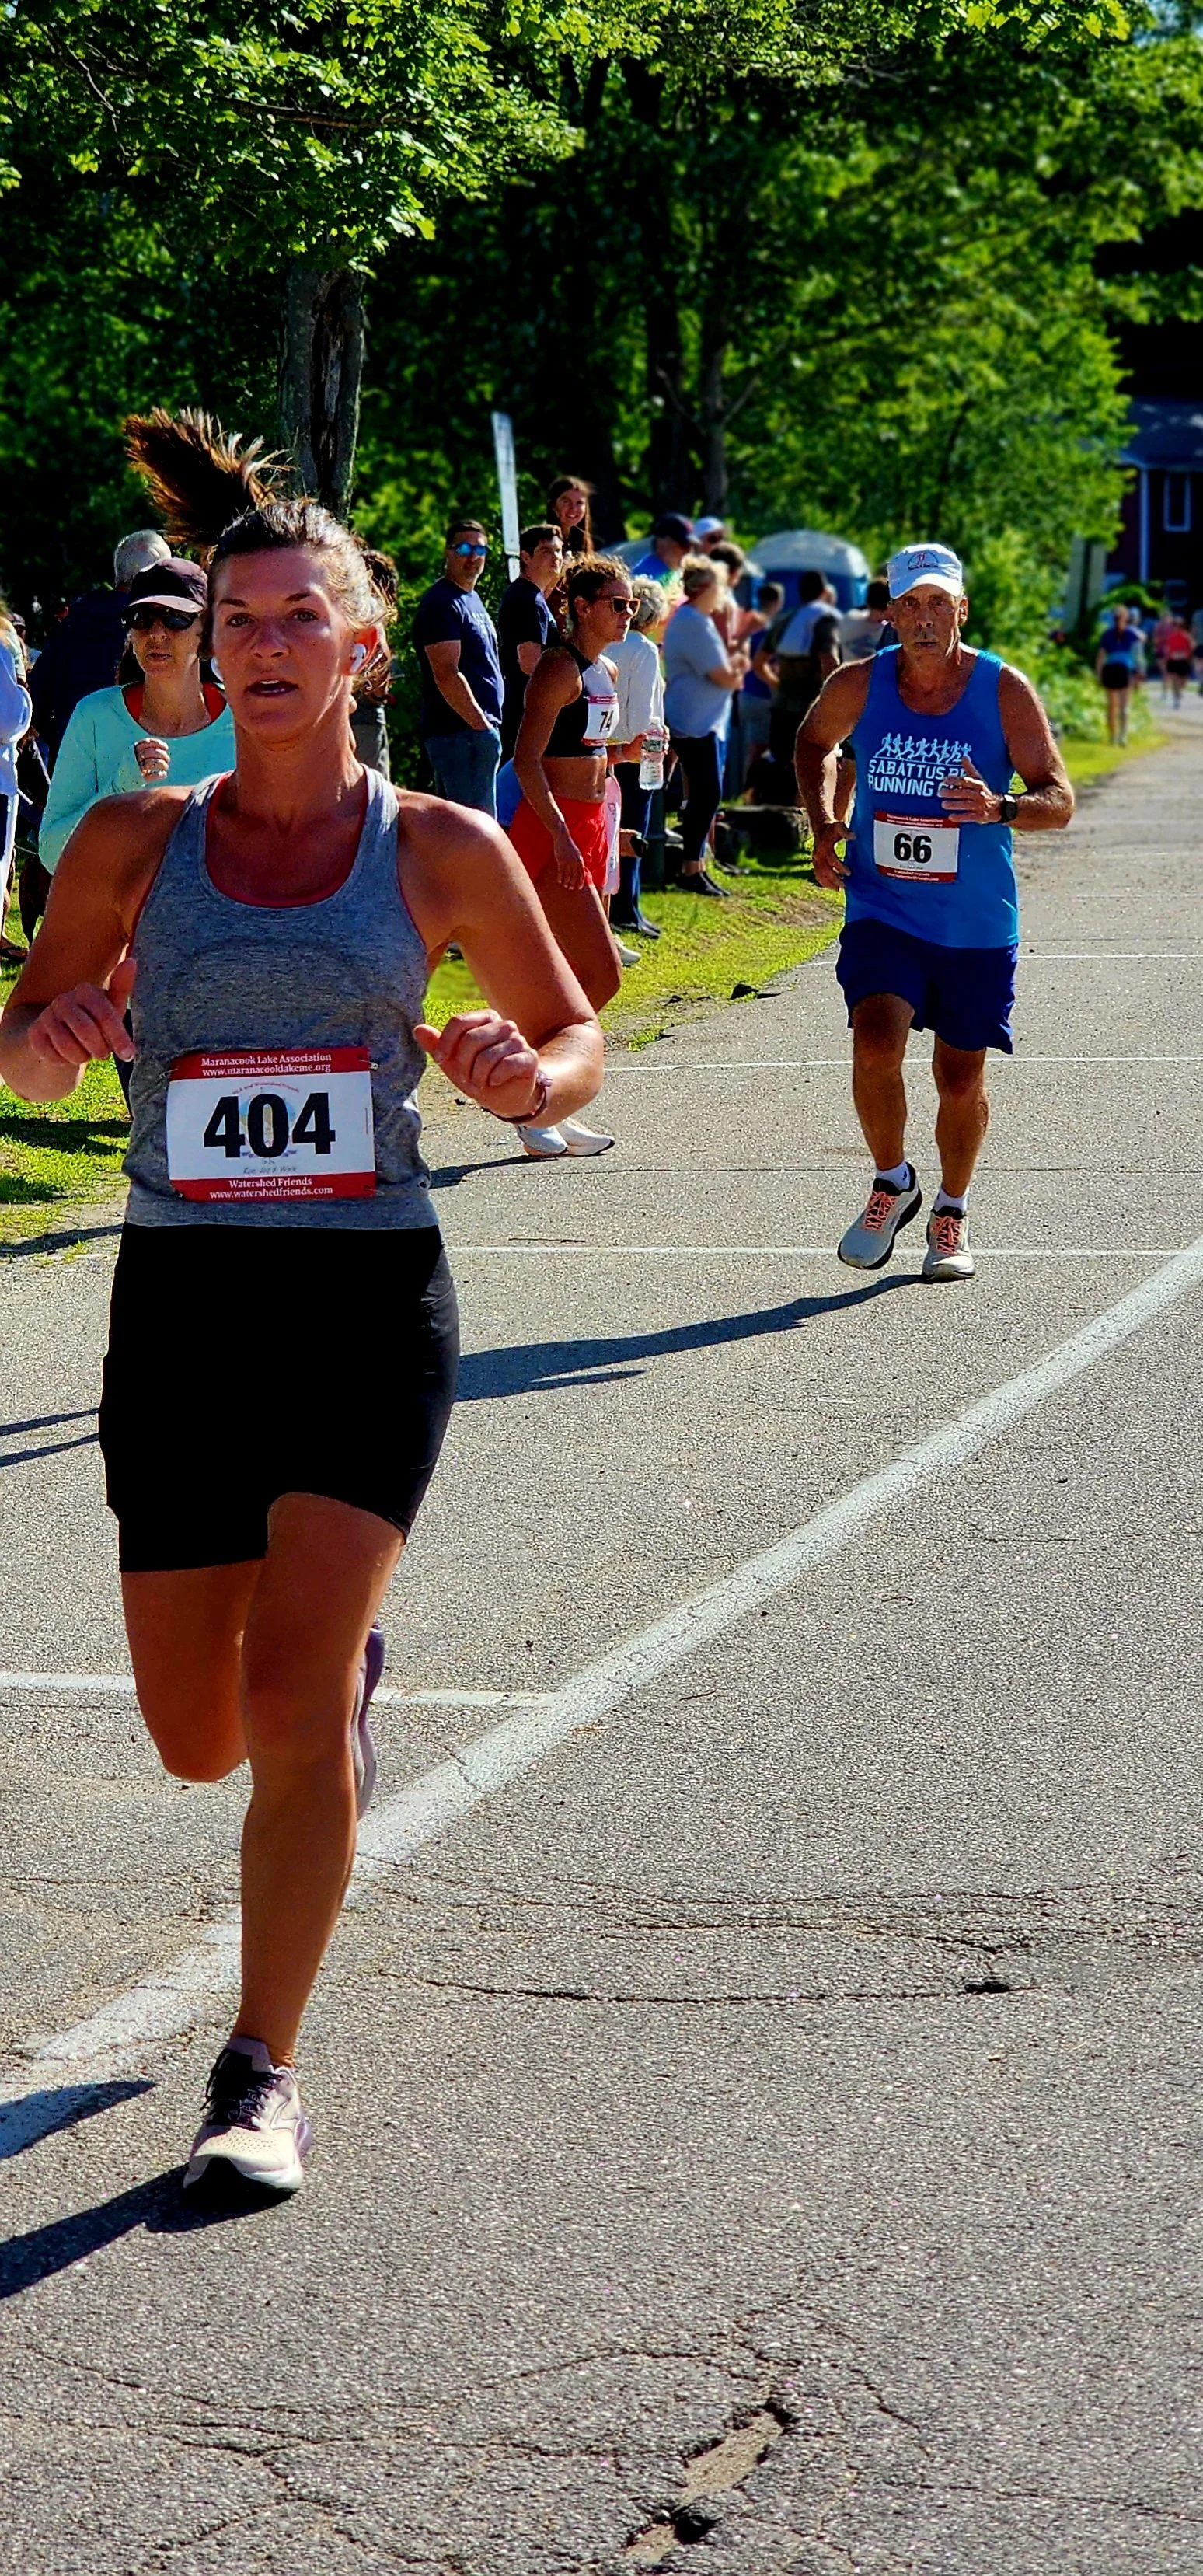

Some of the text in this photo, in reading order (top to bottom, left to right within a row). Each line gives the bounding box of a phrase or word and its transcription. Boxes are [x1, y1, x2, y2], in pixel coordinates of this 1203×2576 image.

[598, 710, 614, 732] 74
[868, 759, 946, 780] SABATTUS
[867, 773, 935, 797] RUNNING
[894, 832, 932, 864] 66
[201, 1052, 332, 1066] Maranacook Lake Association
[202, 1063, 332, 1076] www.maranacooklakeme.org
[204, 1092, 336, 1158] 404
[210, 1186, 333, 1199] www.watershedfriends.com
[228, 1177, 312, 1189] Watershed Friends
